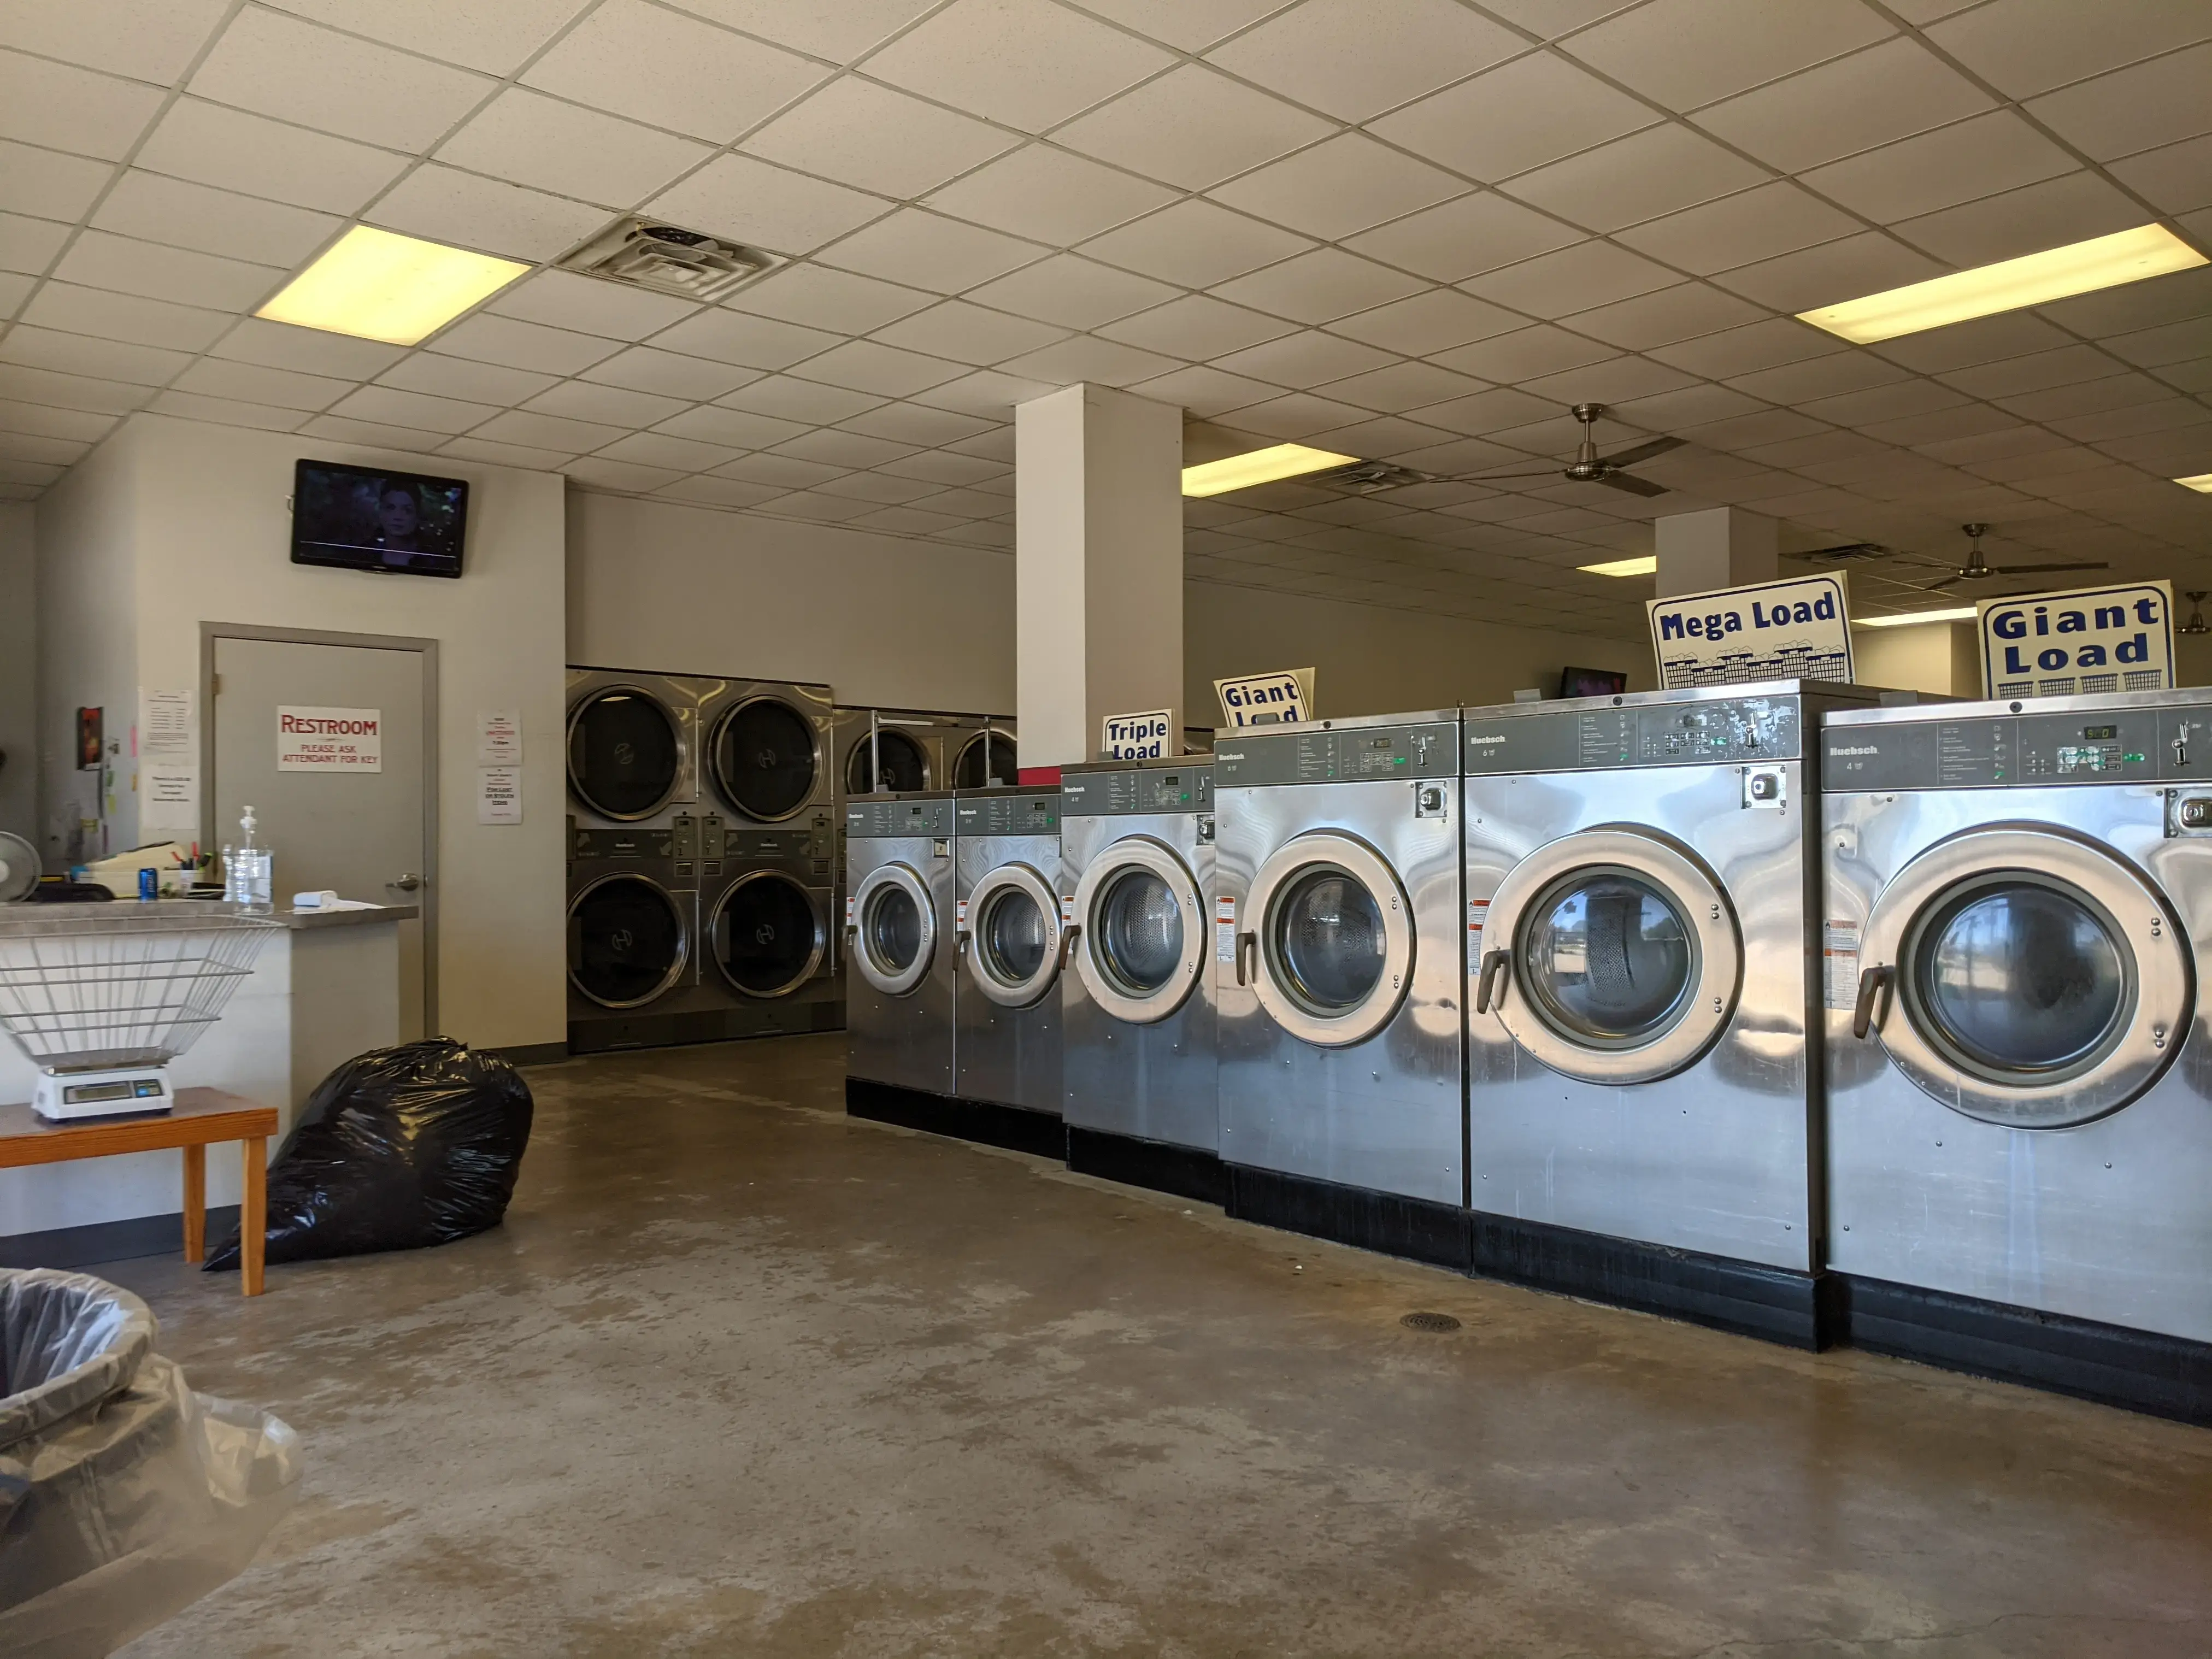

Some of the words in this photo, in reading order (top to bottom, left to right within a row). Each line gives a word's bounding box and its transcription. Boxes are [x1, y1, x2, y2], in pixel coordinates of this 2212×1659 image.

[1660, 610, 1743, 641] Mega
[1751, 591, 1836, 629] Load
[1992, 598, 2159, 639] Giant
[2004, 633, 2149, 674] Load
[1226, 682, 1298, 707] Giant
[1235, 705, 1298, 727] Ld
[1109, 720, 1167, 743] Triple
[1470, 736, 1505, 744] Huebsch
[283, 754, 337, 763] ATTENDANT
[340, 755, 358, 763] FOR
[301, 744, 336, 752] PLEASE
[1113, 740, 1161, 760] Load
[1829, 745, 1878, 756] Huebsch
[1846, 762, 1852, 770] 4
